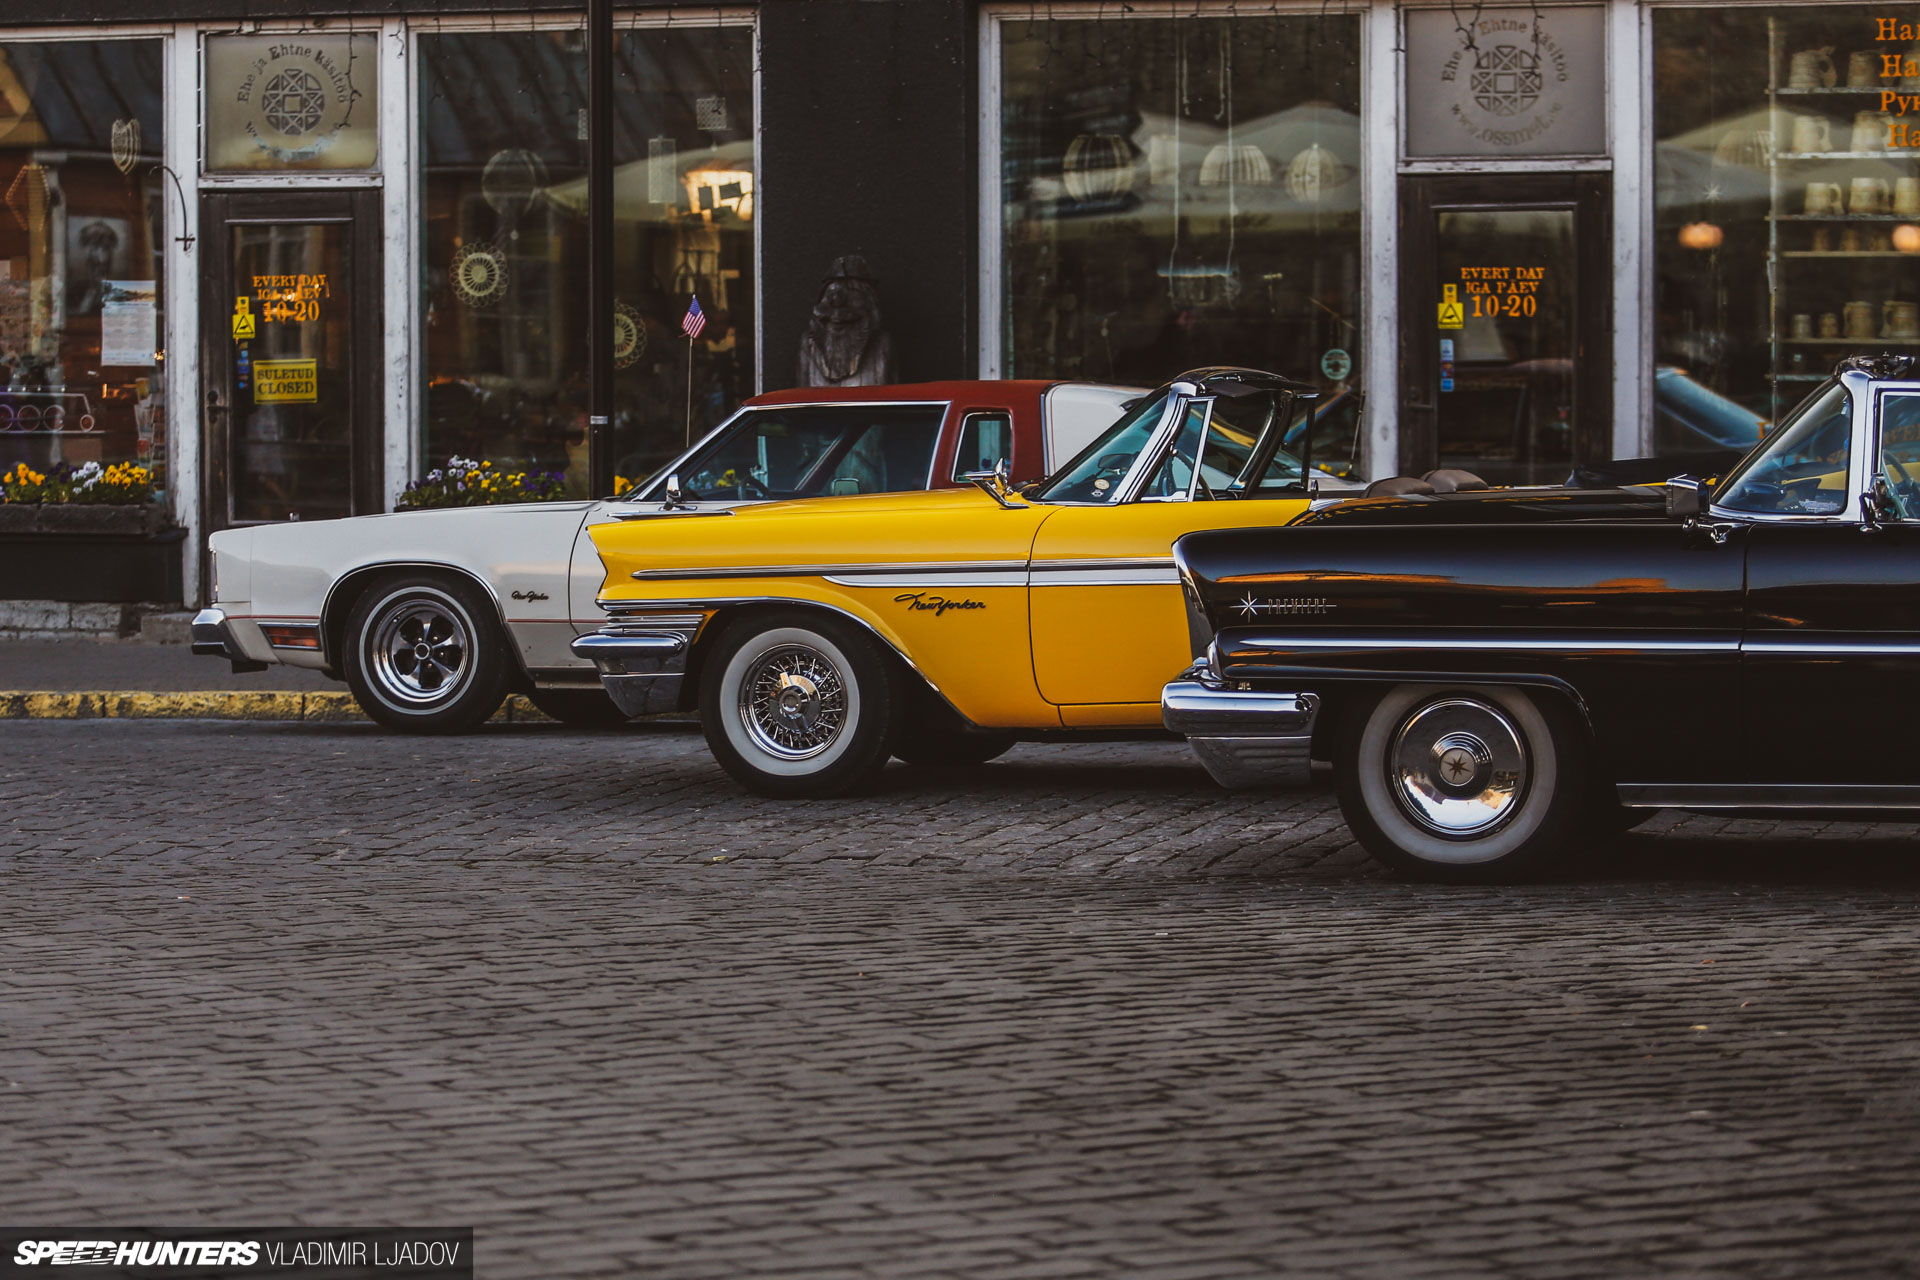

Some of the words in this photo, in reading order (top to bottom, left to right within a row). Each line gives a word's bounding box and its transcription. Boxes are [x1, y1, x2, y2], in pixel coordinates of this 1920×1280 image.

[1441, 50, 1463, 82] Ehe
[1478, 19, 1528, 36] Ehtne
[237, 73, 257, 103] Ehe
[253, 57, 269, 76] ja
[268, 43, 312, 61] Ehtne
[252, 274, 297, 288] EVERY
[301, 273, 327, 287] DAY
[1460, 267, 1511, 280] EVERY
[1516, 266, 1546, 280] DAY
[1465, 281, 1491, 294] IGA
[1496, 279, 1540, 294] PÄEV
[263, 300, 320, 323] 10-20
[1471, 294, 1537, 318] 10-20
[256, 368, 314, 380] SULETUD
[257, 381, 314, 395] CLOSED
[1267, 598, 1327, 615] PREMIERE
